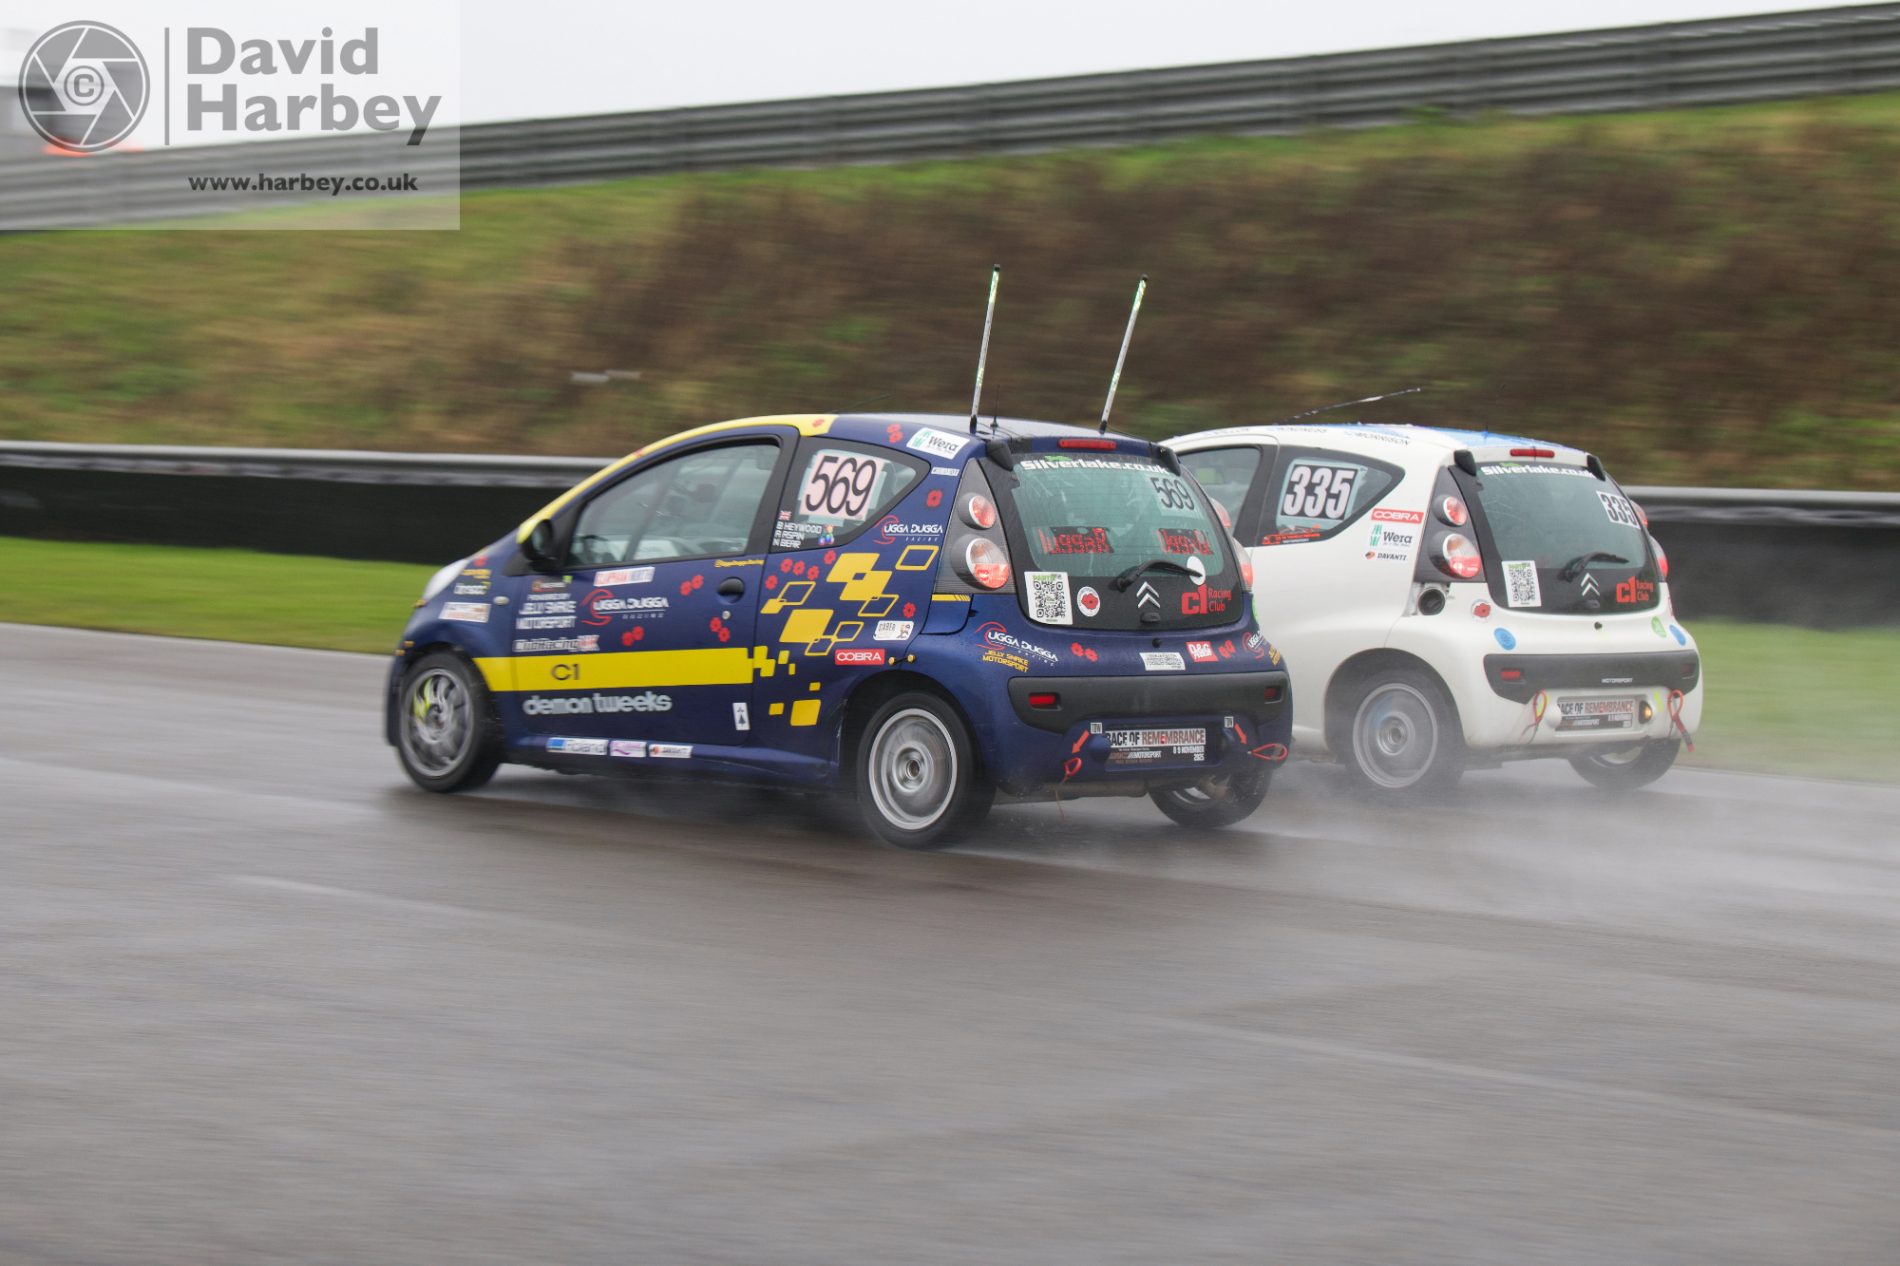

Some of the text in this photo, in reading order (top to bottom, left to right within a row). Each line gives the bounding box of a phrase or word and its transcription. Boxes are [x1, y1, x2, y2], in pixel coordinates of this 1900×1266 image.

[928, 436, 959, 451] Wera
[1020, 459, 1169, 474] Silverlake.co.uk
[805, 455, 877, 517] 569
[1283, 466, 1354, 519] 335
[1150, 477, 1195, 511] 569
[1373, 511, 1420, 522] COBRA
[1601, 494, 1638, 526] 335
[884, 523, 943, 534] UGGA DUGGA
[1383, 531, 1412, 544] Wera
[1377, 552, 1407, 561] DAVANTI
[1208, 588, 1231, 600] Racing
[1208, 600, 1225, 612] Club
[988, 631, 1058, 662] UGGA DUGGA
[836, 652, 882, 662] COBRA
[983, 655, 1028, 673] MOTORSPORT
[551, 664, 580, 681] C1
[522, 691, 672, 715] demon tweeks
[1575, 702, 1584, 715] OF
[1129, 731, 1140, 745] OF
[1141, 729, 1205, 744] REMEMBRANCE
